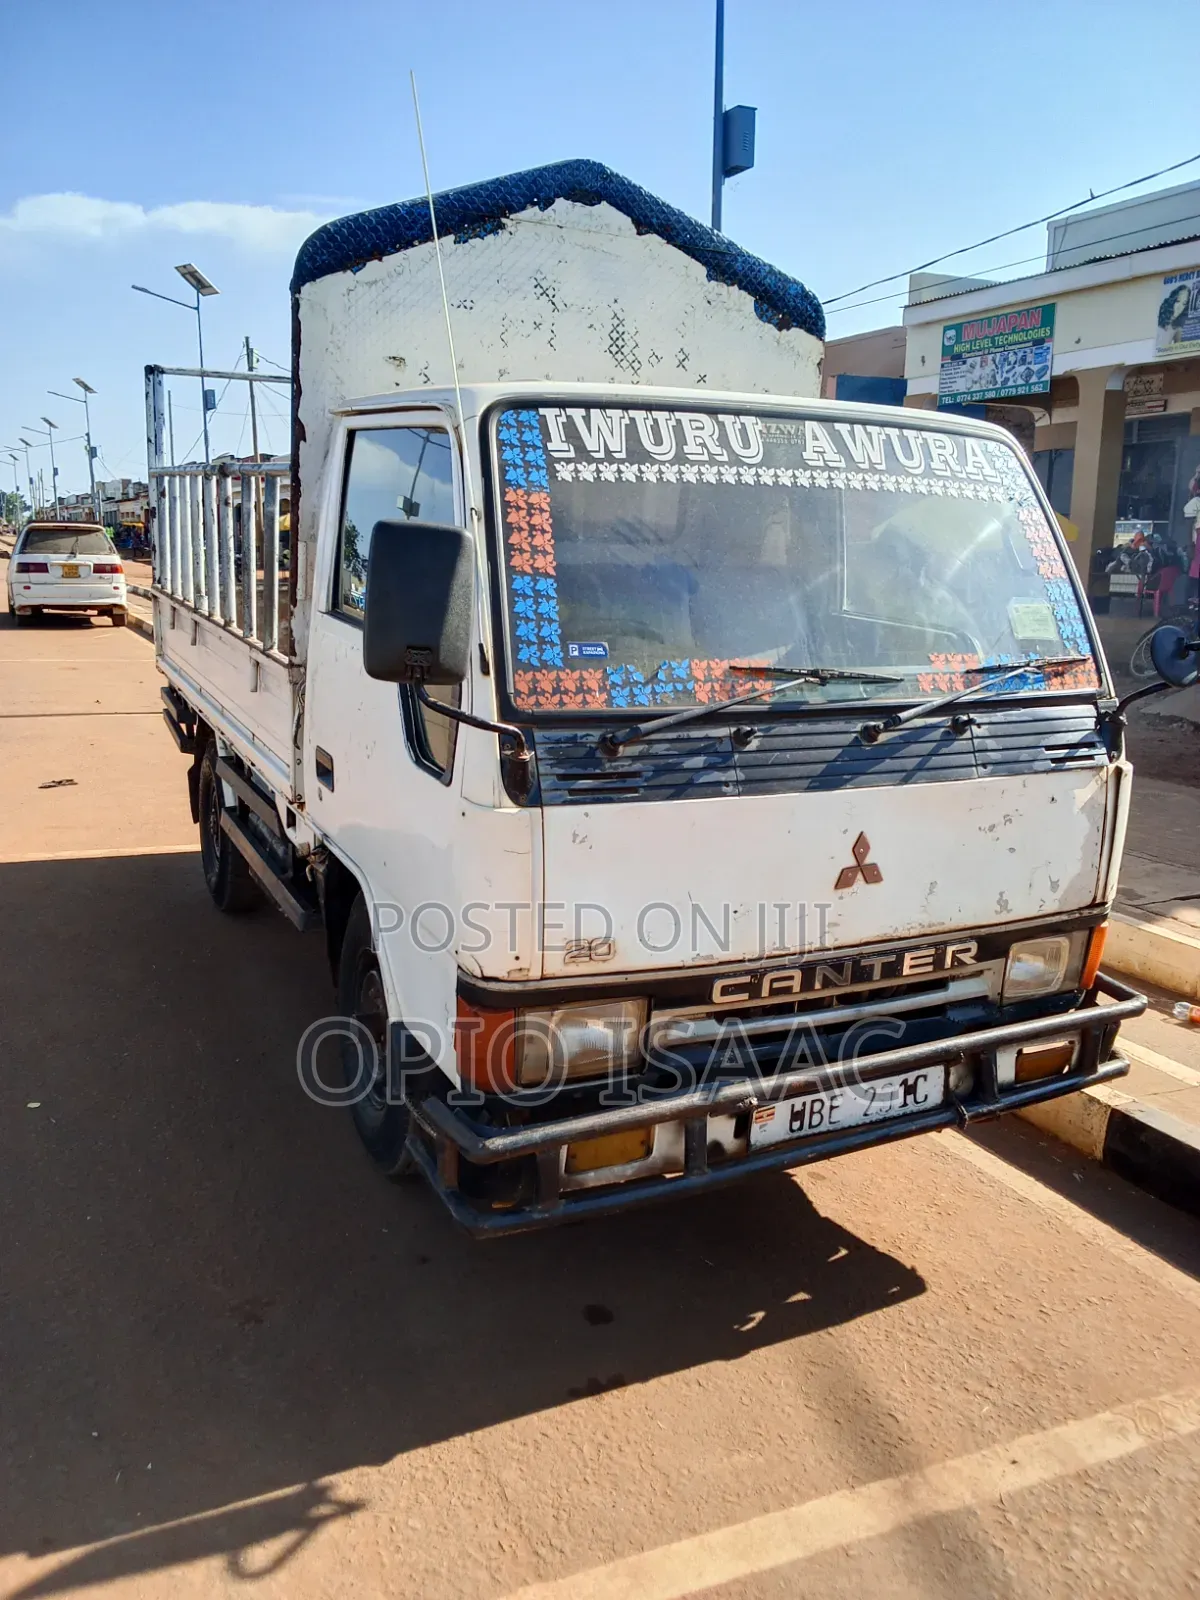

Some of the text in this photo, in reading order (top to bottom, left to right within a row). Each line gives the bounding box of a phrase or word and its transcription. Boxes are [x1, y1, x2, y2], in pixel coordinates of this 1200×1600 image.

[962, 308, 1042, 340] MUJAPAN
[953, 327, 1051, 353] HIGH LEVEL TECHNOLOGIES
[956, 394, 970, 403] 0774
[972, 392, 983, 401] 337
[1000, 388, 1016, 397] 0779
[1017, 386, 1029, 394] 921
[537, 407, 999, 481] IWURU AWURA
[564, 937, 616, 964] 20
[711, 940, 979, 1005] CANTER
